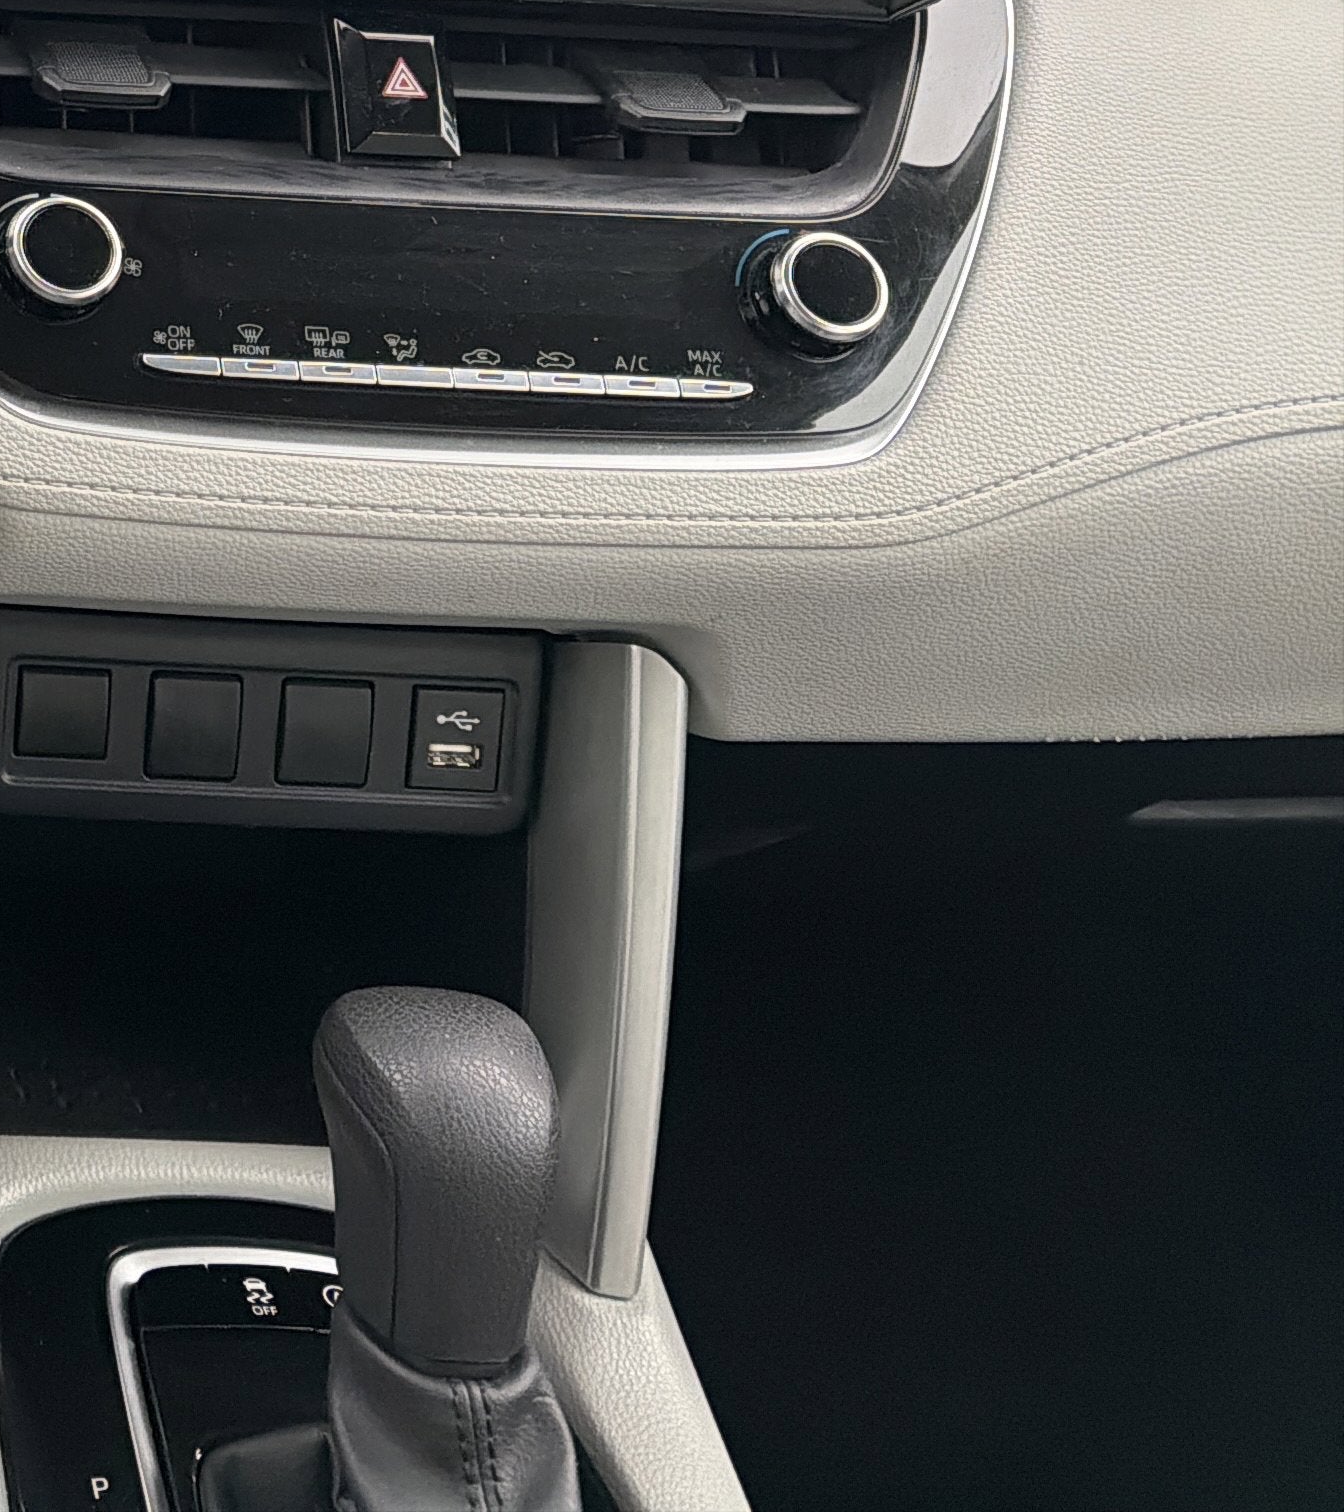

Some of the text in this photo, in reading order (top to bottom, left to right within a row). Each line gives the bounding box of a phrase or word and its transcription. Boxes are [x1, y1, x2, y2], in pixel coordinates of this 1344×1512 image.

[167, 325, 192, 338] ON
[167, 339, 195, 351] OFF
[232, 344, 271, 357] FRONT
[313, 348, 345, 359] REAR
[687, 349, 723, 365] MAX
[615, 355, 649, 373] A/C
[694, 364, 722, 377] A/C
[252, 1305, 278, 1317] OFF
[90, 1477, 110, 1500] P
